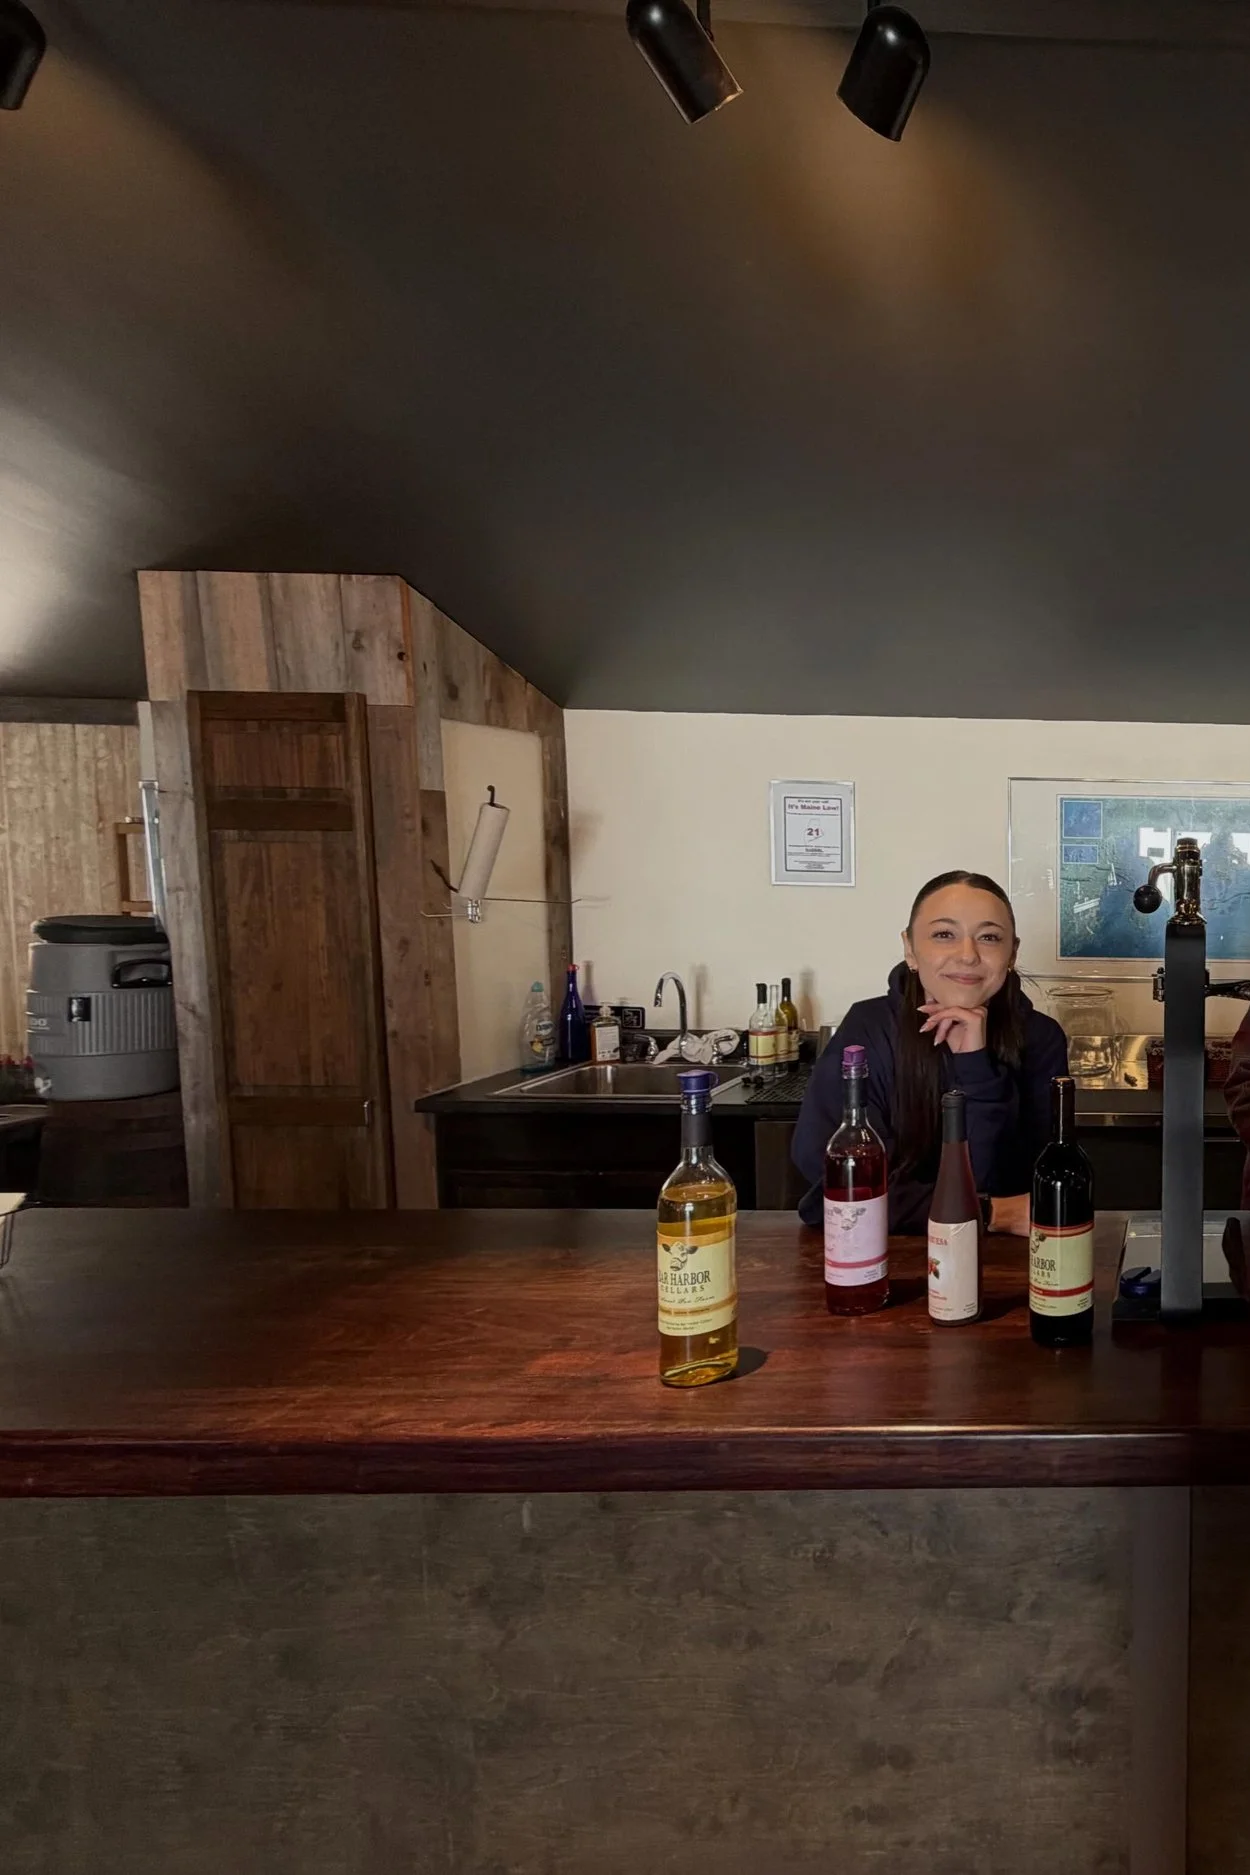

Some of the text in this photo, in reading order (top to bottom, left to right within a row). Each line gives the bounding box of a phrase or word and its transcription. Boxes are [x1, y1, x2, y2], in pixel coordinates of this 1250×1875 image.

[807, 828, 820, 836] 21
[659, 1270, 711, 1286] AR HARBOR
